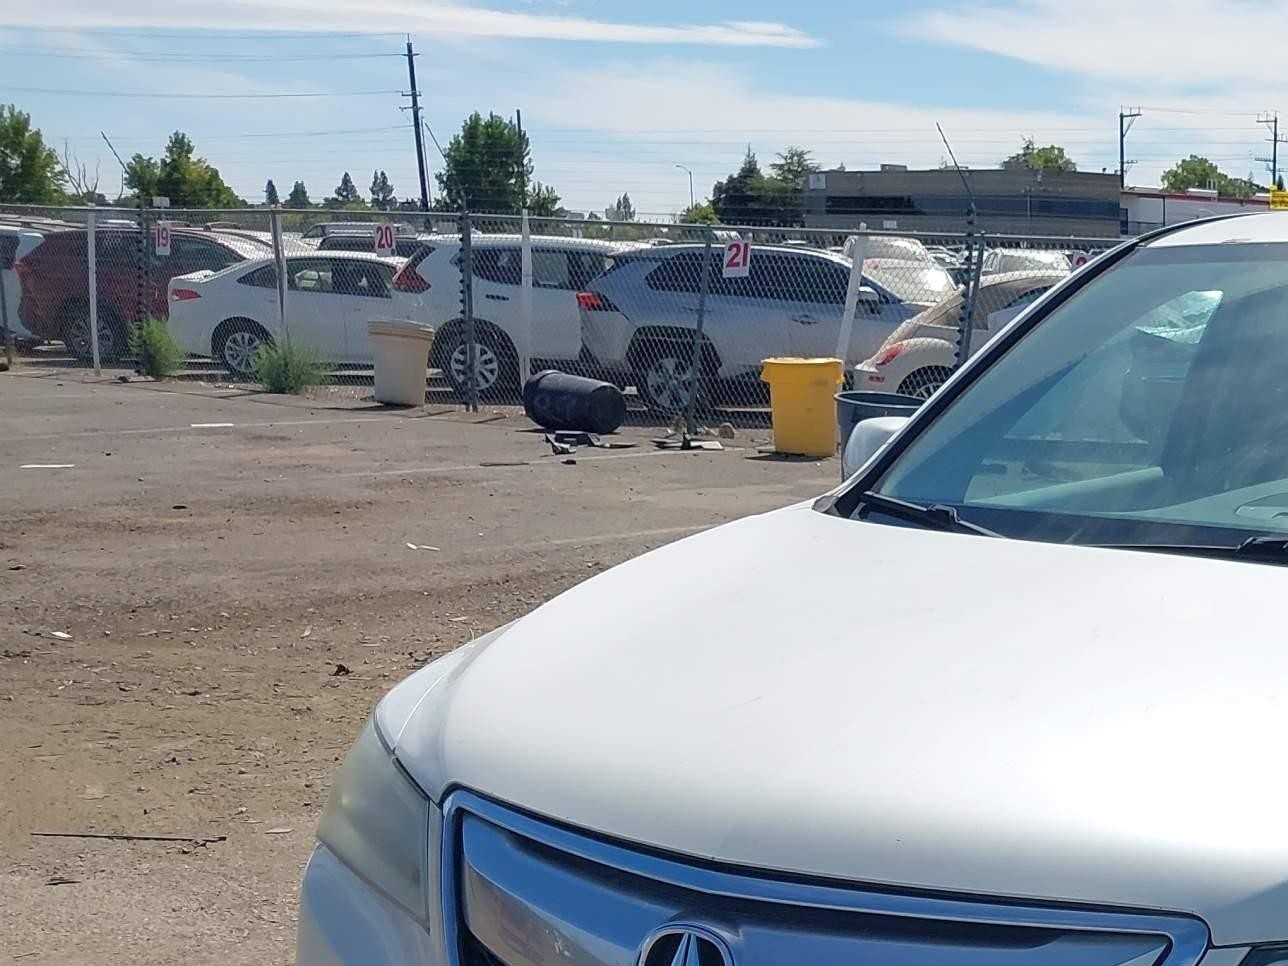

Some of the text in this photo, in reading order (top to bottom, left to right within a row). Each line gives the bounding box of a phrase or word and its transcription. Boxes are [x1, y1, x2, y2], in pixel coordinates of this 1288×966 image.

[157, 227, 168, 248] 19
[376, 226, 393, 249] 20
[726, 243, 749, 267] 21
